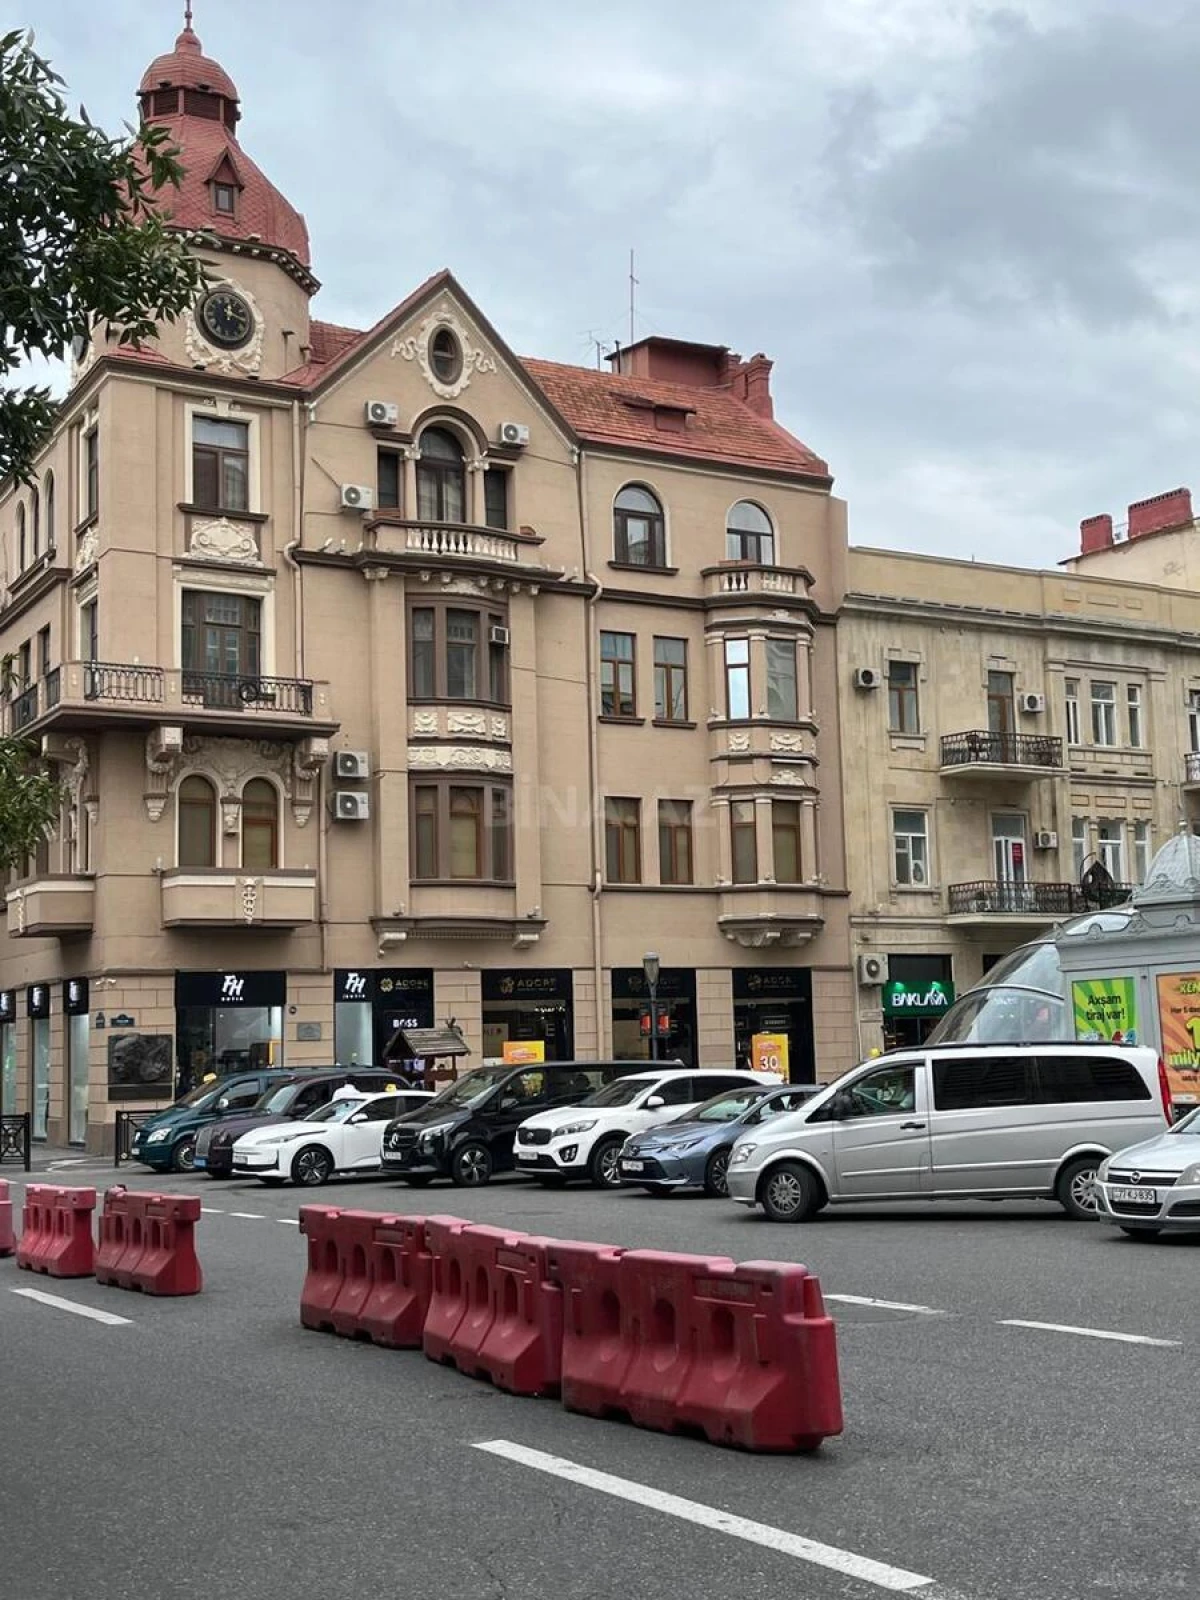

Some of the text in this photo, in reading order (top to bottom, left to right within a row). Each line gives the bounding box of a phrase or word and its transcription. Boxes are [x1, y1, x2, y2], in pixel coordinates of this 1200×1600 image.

[1087, 994, 1122, 1006] Axşam
[1086, 1008, 1125, 1023] tiraj var!
[759, 1055, 779, 1070] 30
